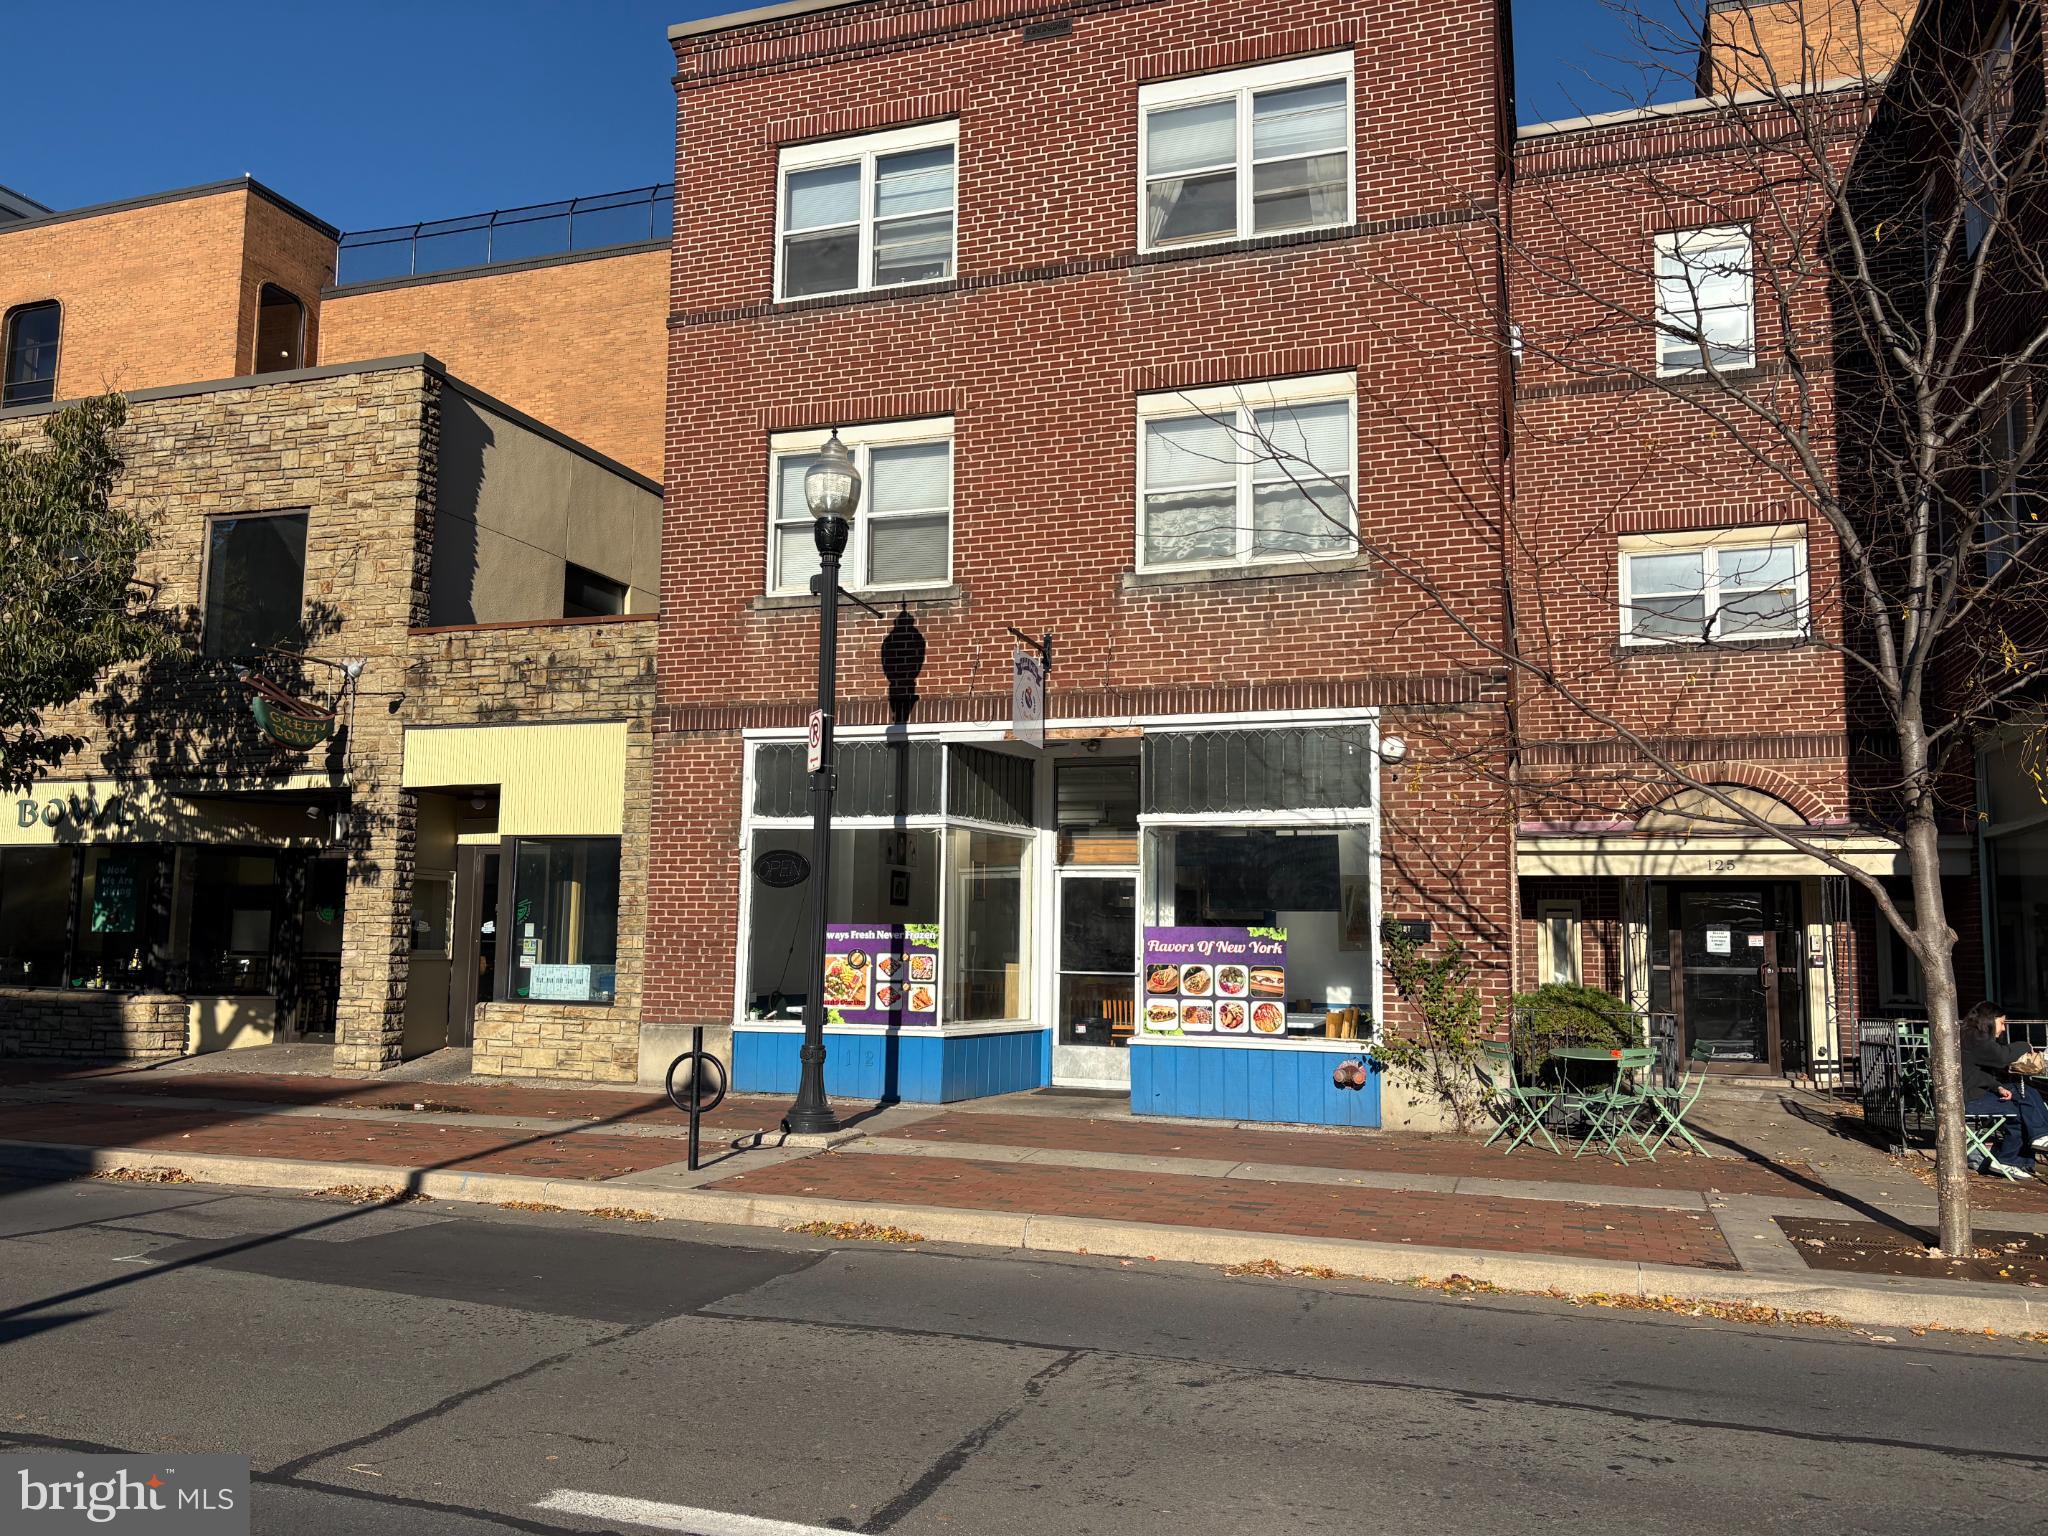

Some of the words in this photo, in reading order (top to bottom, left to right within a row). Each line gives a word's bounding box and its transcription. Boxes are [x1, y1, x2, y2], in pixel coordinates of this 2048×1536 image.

[270, 711, 327, 731] GREEN
[273, 723, 319, 743] BOWL
[16, 795, 134, 827] BOWL
[106, 865, 128, 875] Now
[758, 860, 801, 879] OPEN
[1707, 859, 1736, 871] 125
[826, 932, 849, 941] ways
[850, 930, 875, 940] Fresh
[876, 930, 904, 940] Never
[904, 931, 936, 940] Frozen
[1147, 939, 1194, 953] Flavors
[1196, 940, 1215, 956] Of
[1216, 941, 1246, 953] New
[1248, 941, 1283, 954] York
